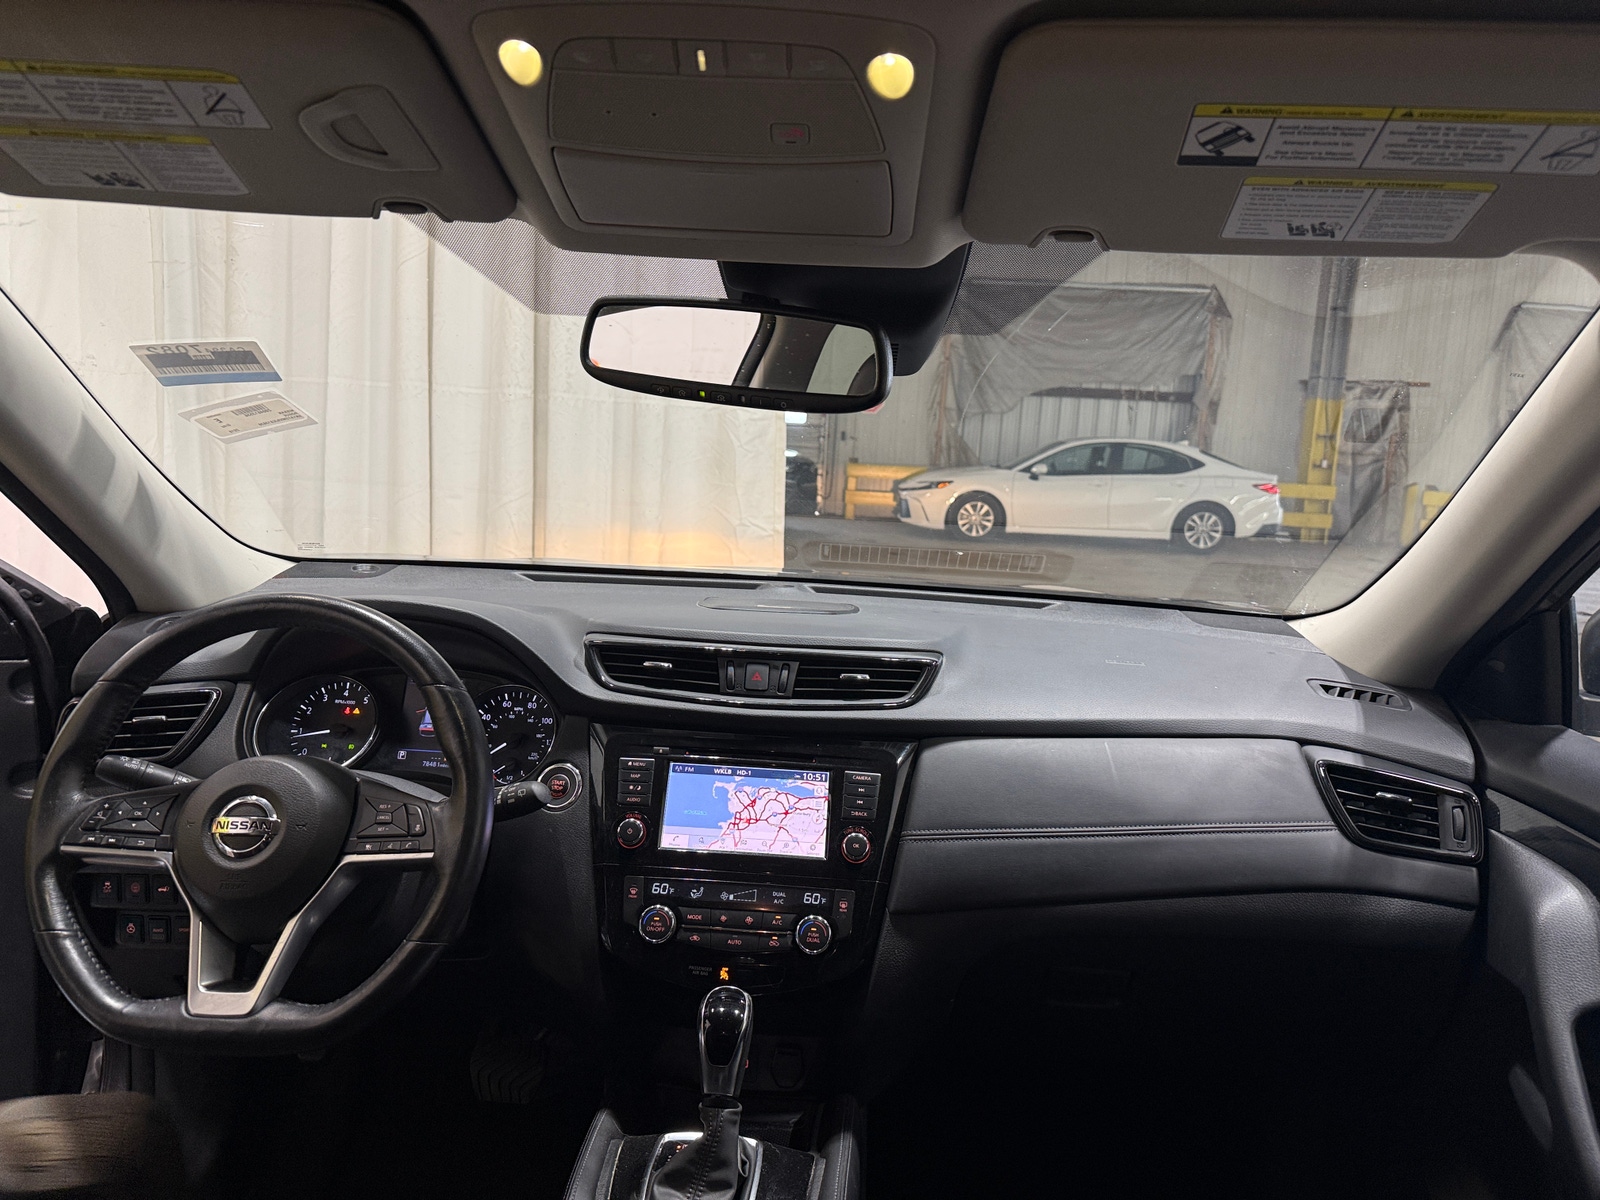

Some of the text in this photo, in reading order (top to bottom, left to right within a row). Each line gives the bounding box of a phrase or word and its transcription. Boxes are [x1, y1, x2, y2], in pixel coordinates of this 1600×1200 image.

[1236, 108, 1283, 116] WARNING
[322, 694, 328, 702] 3
[306, 707, 312, 715] 2
[481, 713, 492, 721] 40
[541, 717, 553, 725] 100
[301, 748, 308, 756] 0
[802, 772, 827, 782] 10:51
[216, 820, 272, 831] NISSAN
